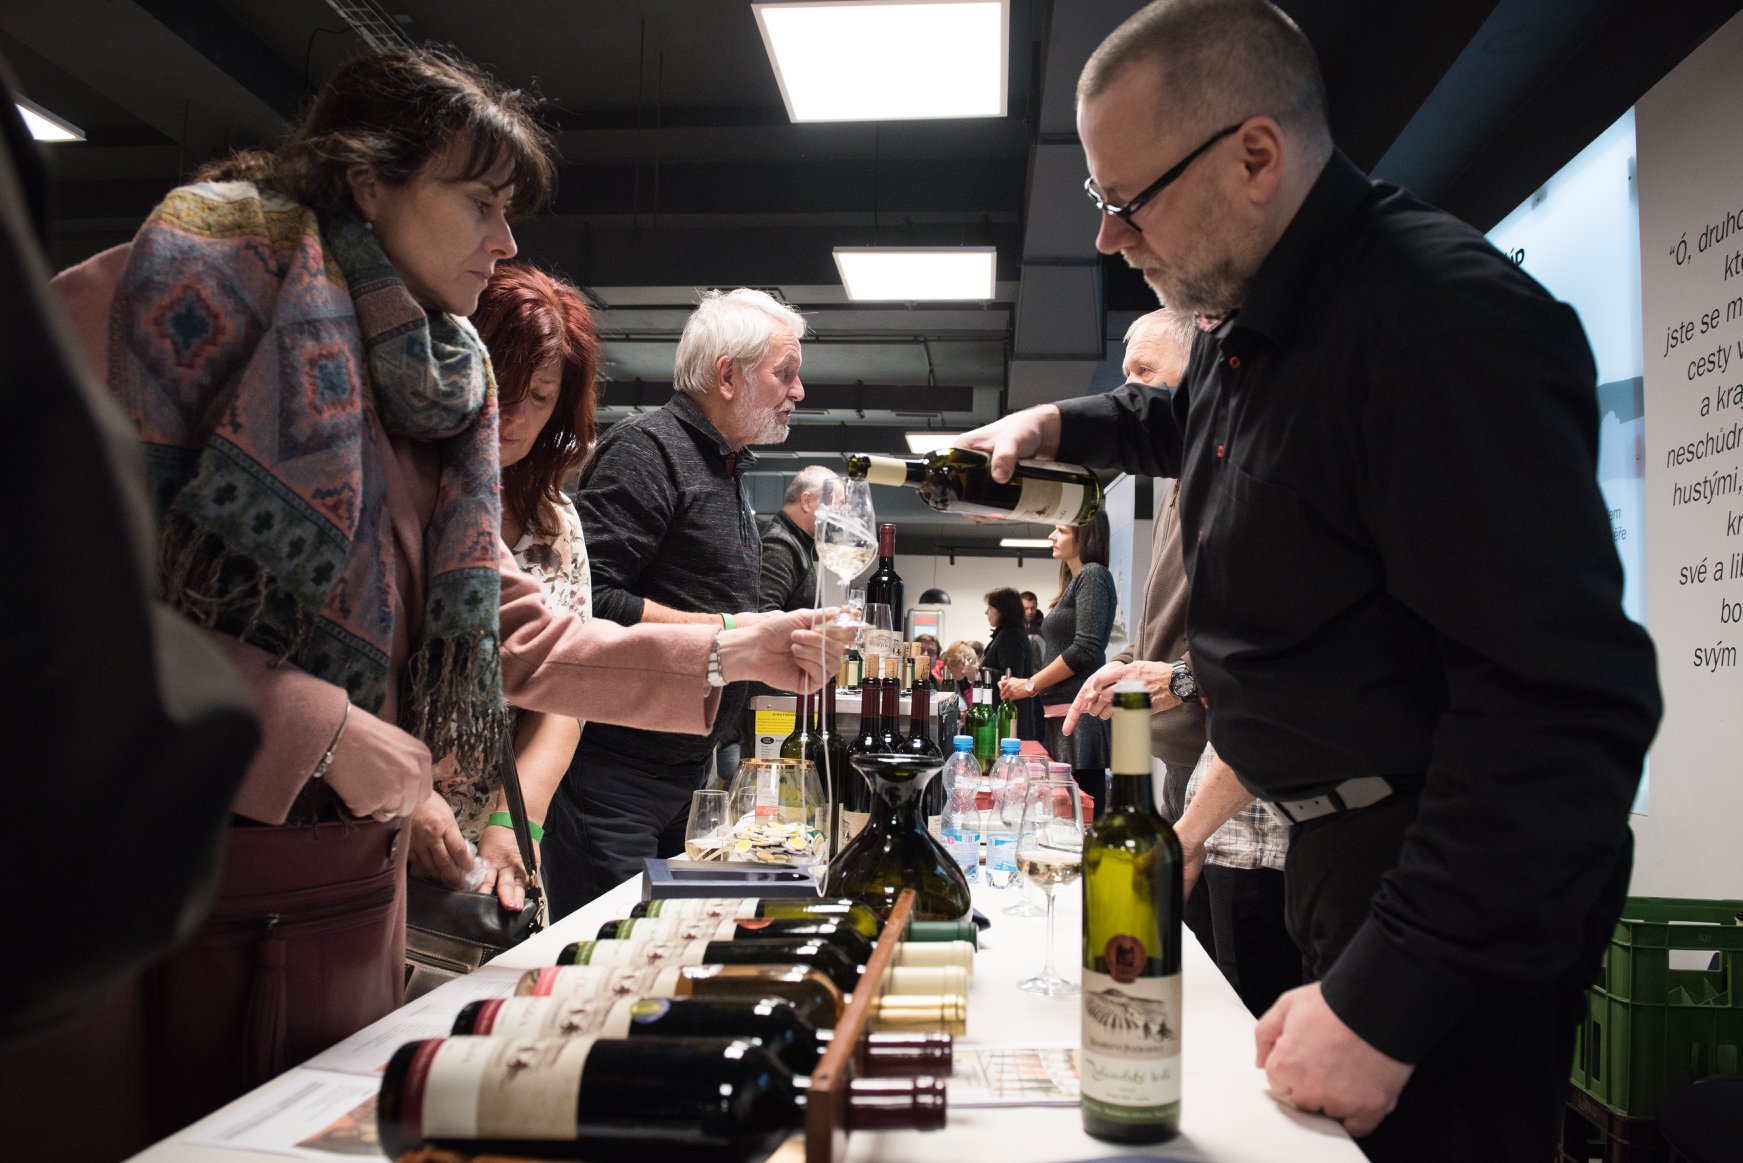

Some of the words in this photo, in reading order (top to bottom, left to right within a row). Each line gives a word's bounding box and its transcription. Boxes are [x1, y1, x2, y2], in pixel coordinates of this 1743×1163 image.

[1664, 321, 1695, 358] jste
[1700, 308, 1720, 335] se
[1687, 344, 1732, 381] cesty
[1700, 396, 1710, 417] a
[1716, 383, 1743, 411] kra
[1673, 466, 1742, 506] hustými,
[1679, 557, 1707, 585] své
[1713, 561, 1724, 581] a
[1720, 598, 1742, 624] bo
[1693, 641, 1737, 673] svým
